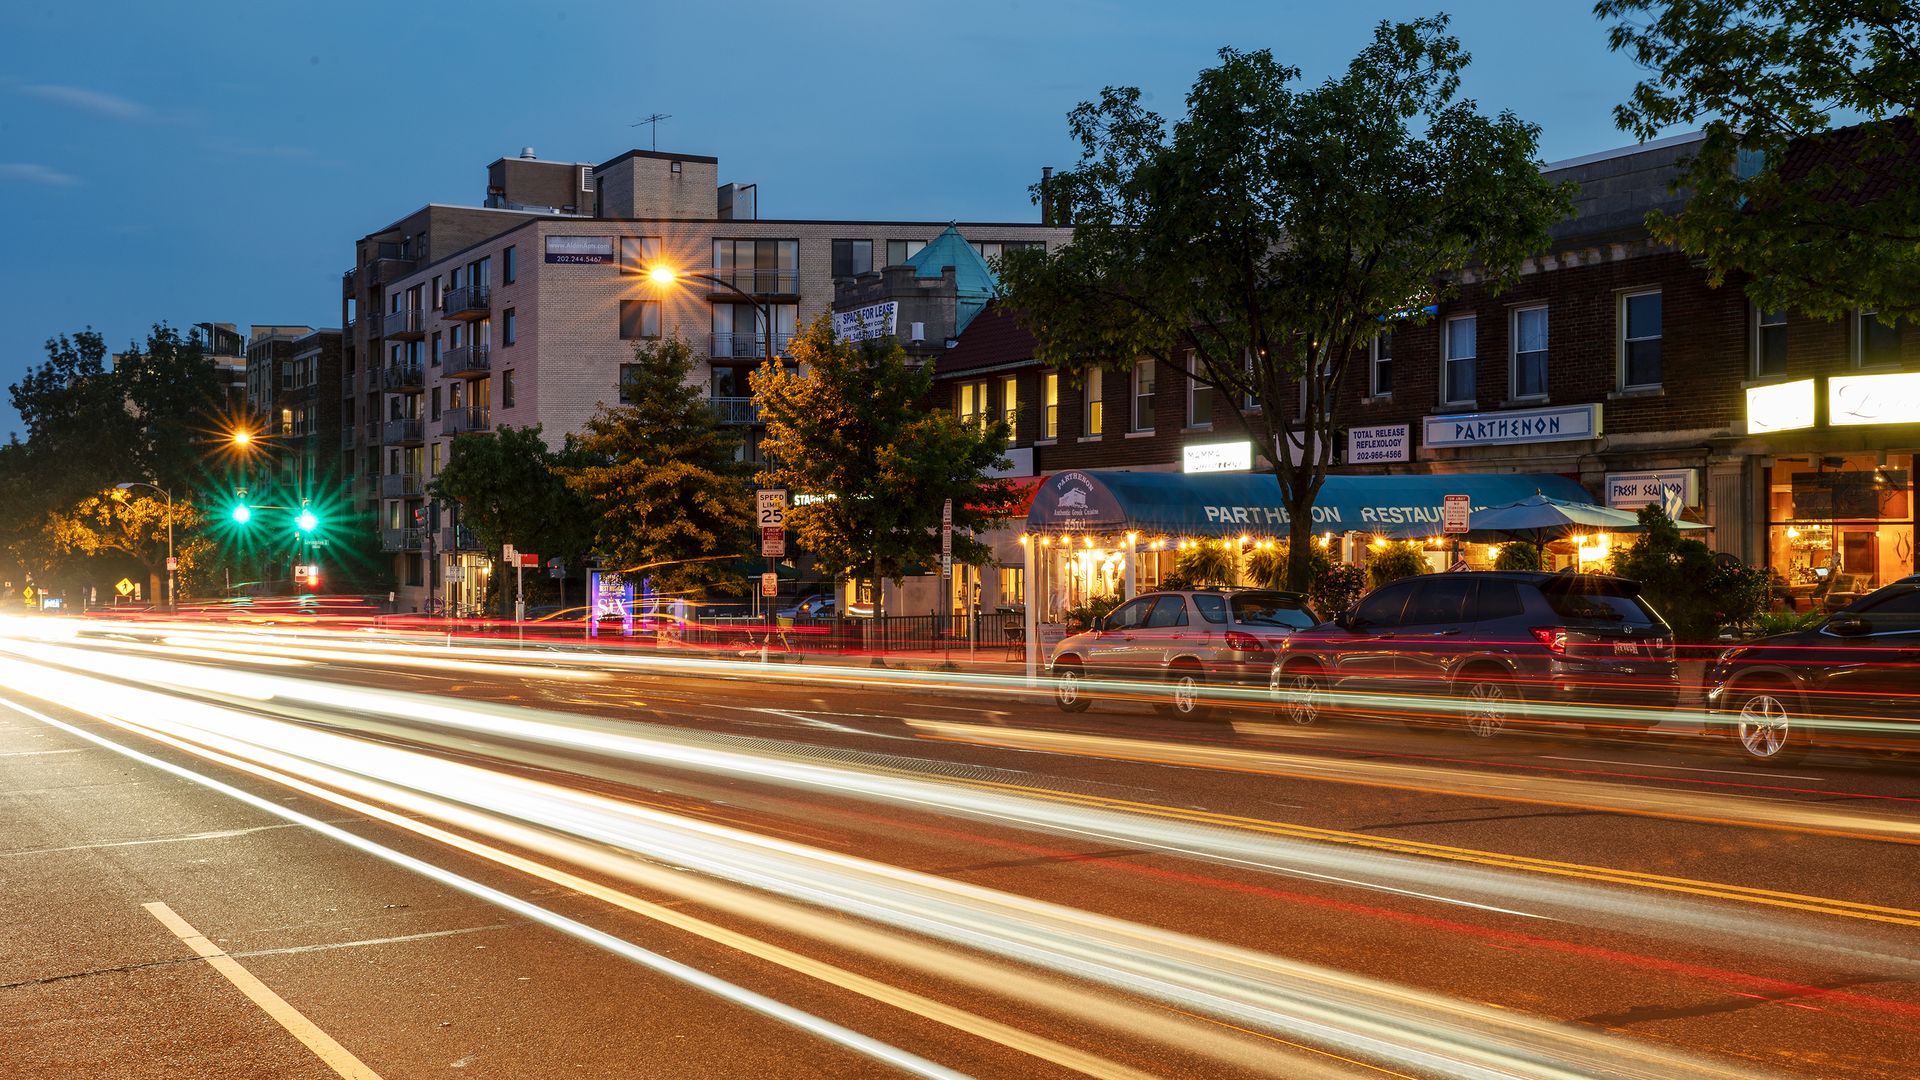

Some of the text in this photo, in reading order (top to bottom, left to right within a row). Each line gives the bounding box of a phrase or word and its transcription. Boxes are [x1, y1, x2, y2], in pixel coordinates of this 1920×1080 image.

[556, 255, 602, 263] 202.244.5467
[862, 307, 874, 320] FOR
[875, 303, 894, 318] LEASE
[1353, 428, 1405, 439] TOTAL RELEASE
[1455, 416, 1560, 440] PARTHENON
[1356, 438, 1402, 449] REFLEXOLOGY
[1057, 472, 1094, 492] PARTHENON
[1613, 483, 1682, 497] FRESH SEAOD
[761, 509, 784, 523] 25
[1204, 506, 1489, 524] PARTHEON RESTAU
